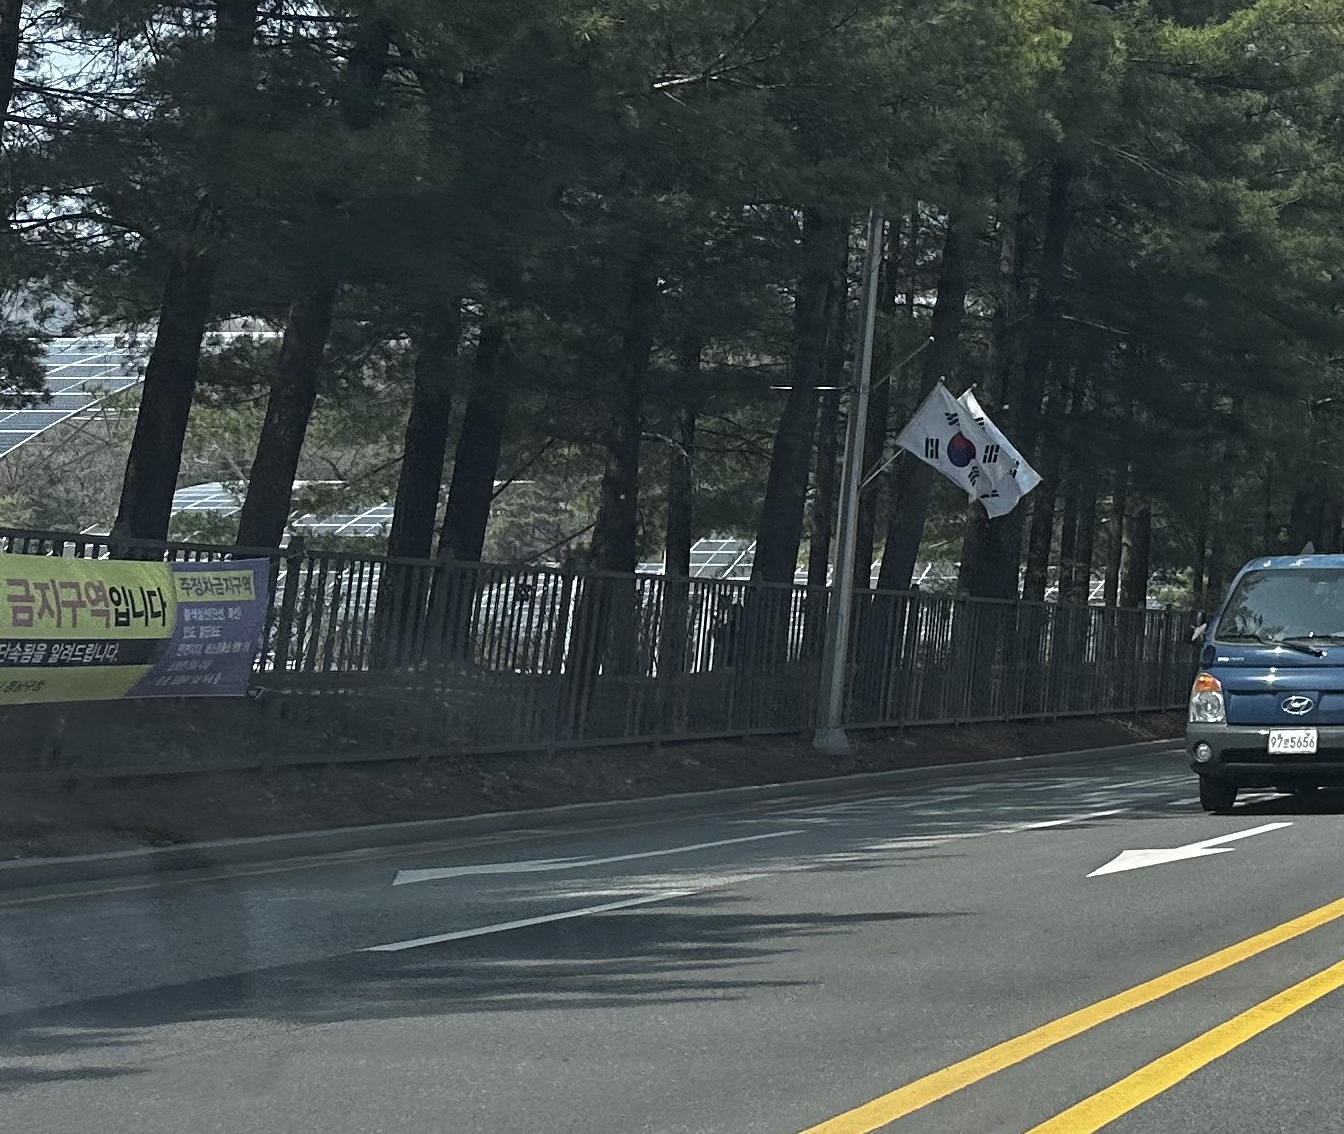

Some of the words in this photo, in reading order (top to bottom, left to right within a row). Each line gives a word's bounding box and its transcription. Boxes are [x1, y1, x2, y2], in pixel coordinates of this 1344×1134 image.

[178, 575, 253, 597] 주정차금지구역
[6, 578, 167, 629] 금지구역입니다
[48, 642, 120, 664] 알려드립니다.
